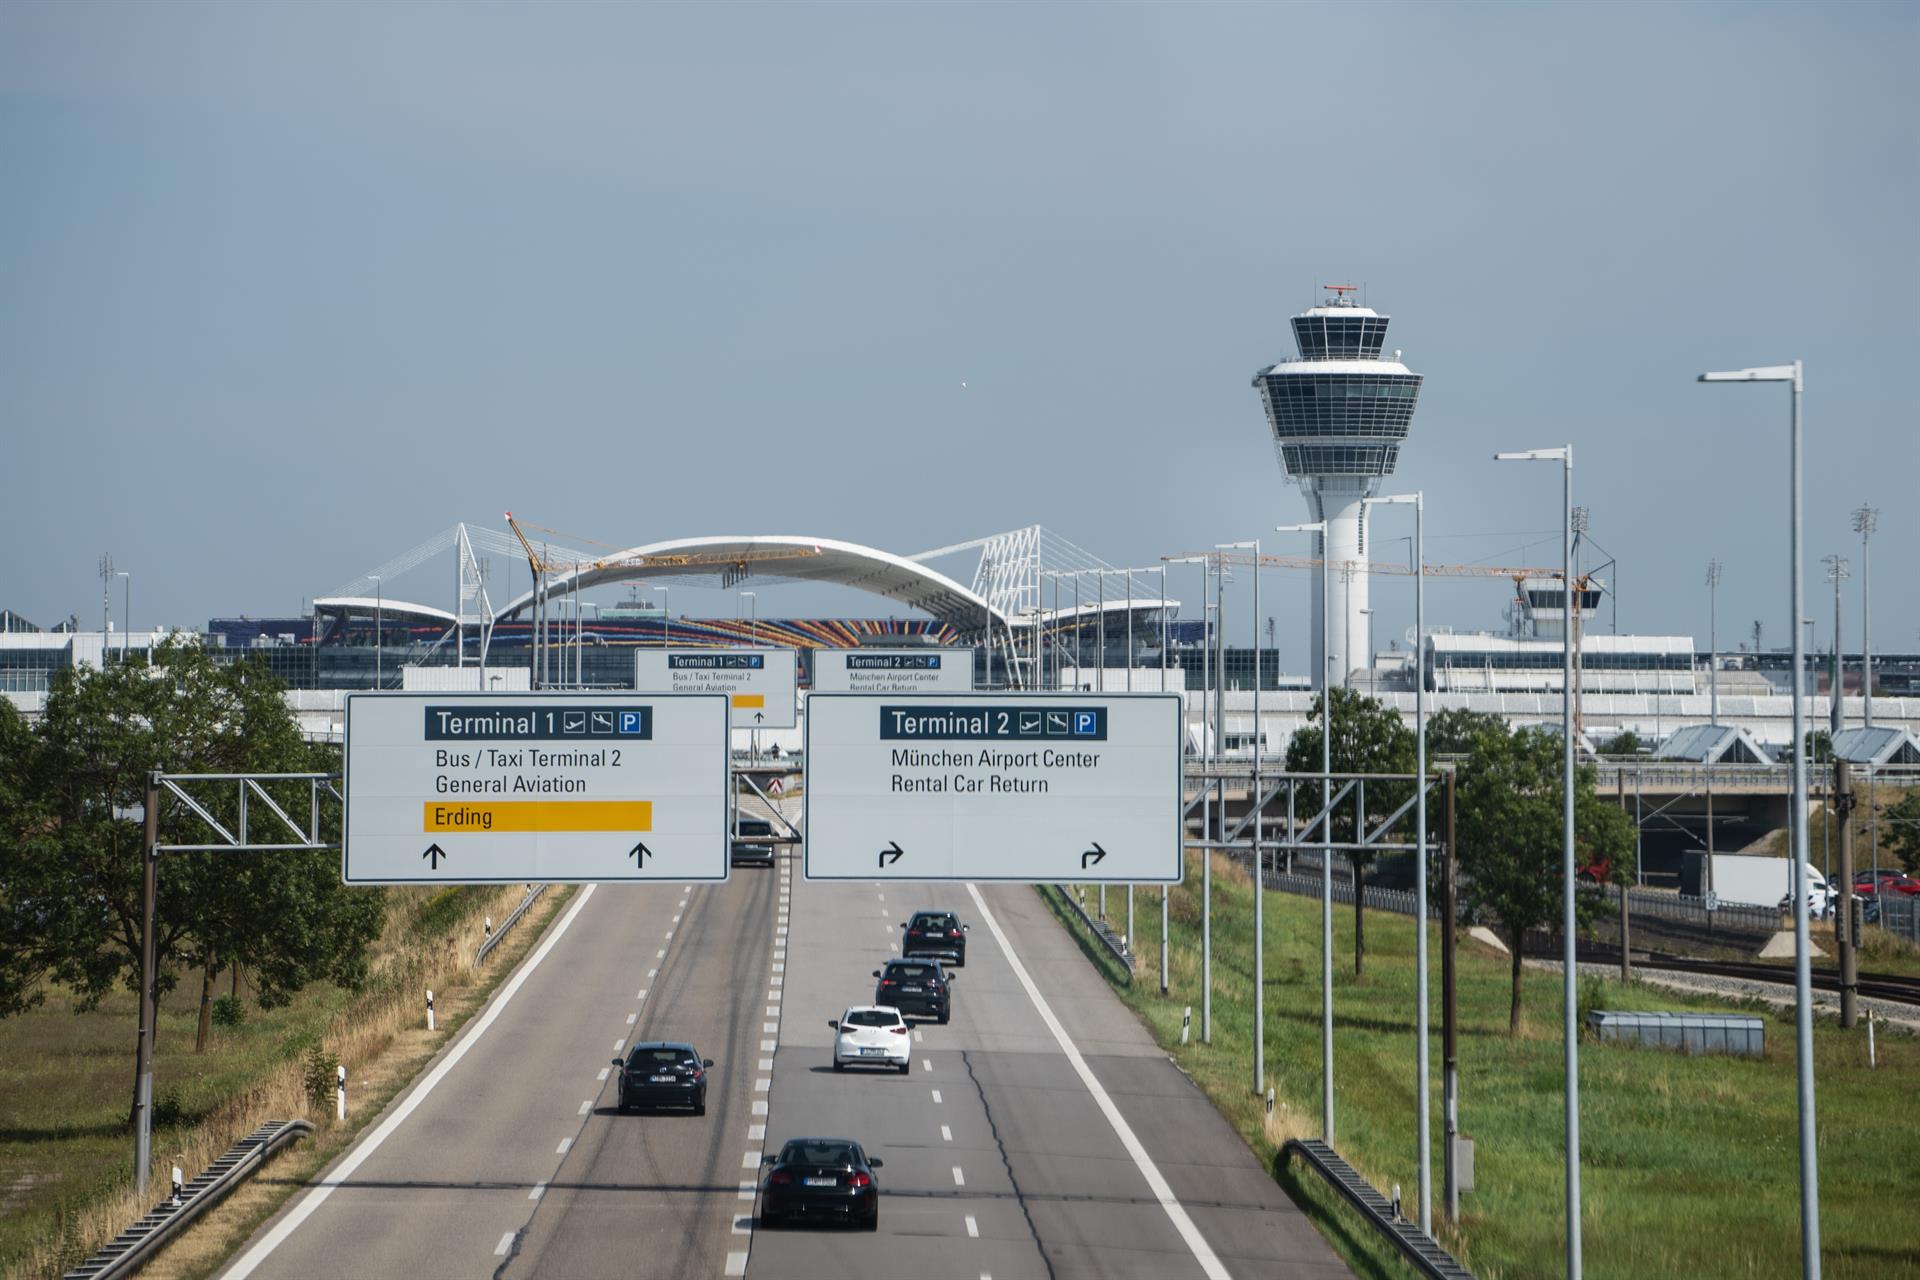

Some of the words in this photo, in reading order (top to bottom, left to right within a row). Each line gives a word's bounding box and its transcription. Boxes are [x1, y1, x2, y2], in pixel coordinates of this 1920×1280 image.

[673, 656, 716, 667] Terminal
[719, 656, 723, 667] 1
[850, 656, 892, 667] Terminal
[895, 656, 900, 667] 2
[672, 672, 688, 681] Bus
[694, 672, 710, 681] Taxi
[712, 672, 745, 681] Terminal
[746, 672, 752, 681] 2
[850, 672, 885, 681] München
[887, 672, 913, 683] Airport
[914, 672, 939, 681] Center
[672, 683, 704, 692] General
[705, 683, 737, 692] Aviation
[876, 683, 890, 691] Car
[437, 711, 536, 734] Terminal
[546, 711, 555, 734] 1
[892, 711, 989, 734] Terminal
[997, 711, 1010, 734] 2
[436, 750, 470, 767] Bus
[475, 749, 482, 769] /
[487, 749, 523, 767] Taxi
[528, 749, 605, 767] Terminal
[611, 749, 622, 767] 2
[892, 748, 973, 768] München
[978, 749, 1038, 771] Airport
[1043, 749, 1100, 768] Center
[436, 775, 507, 793] General
[513, 775, 586, 793] Aviation
[892, 774, 948, 793] Rental
[954, 775, 983, 793] Car
[990, 775, 1049, 793] Return
[435, 807, 492, 829] Erding
